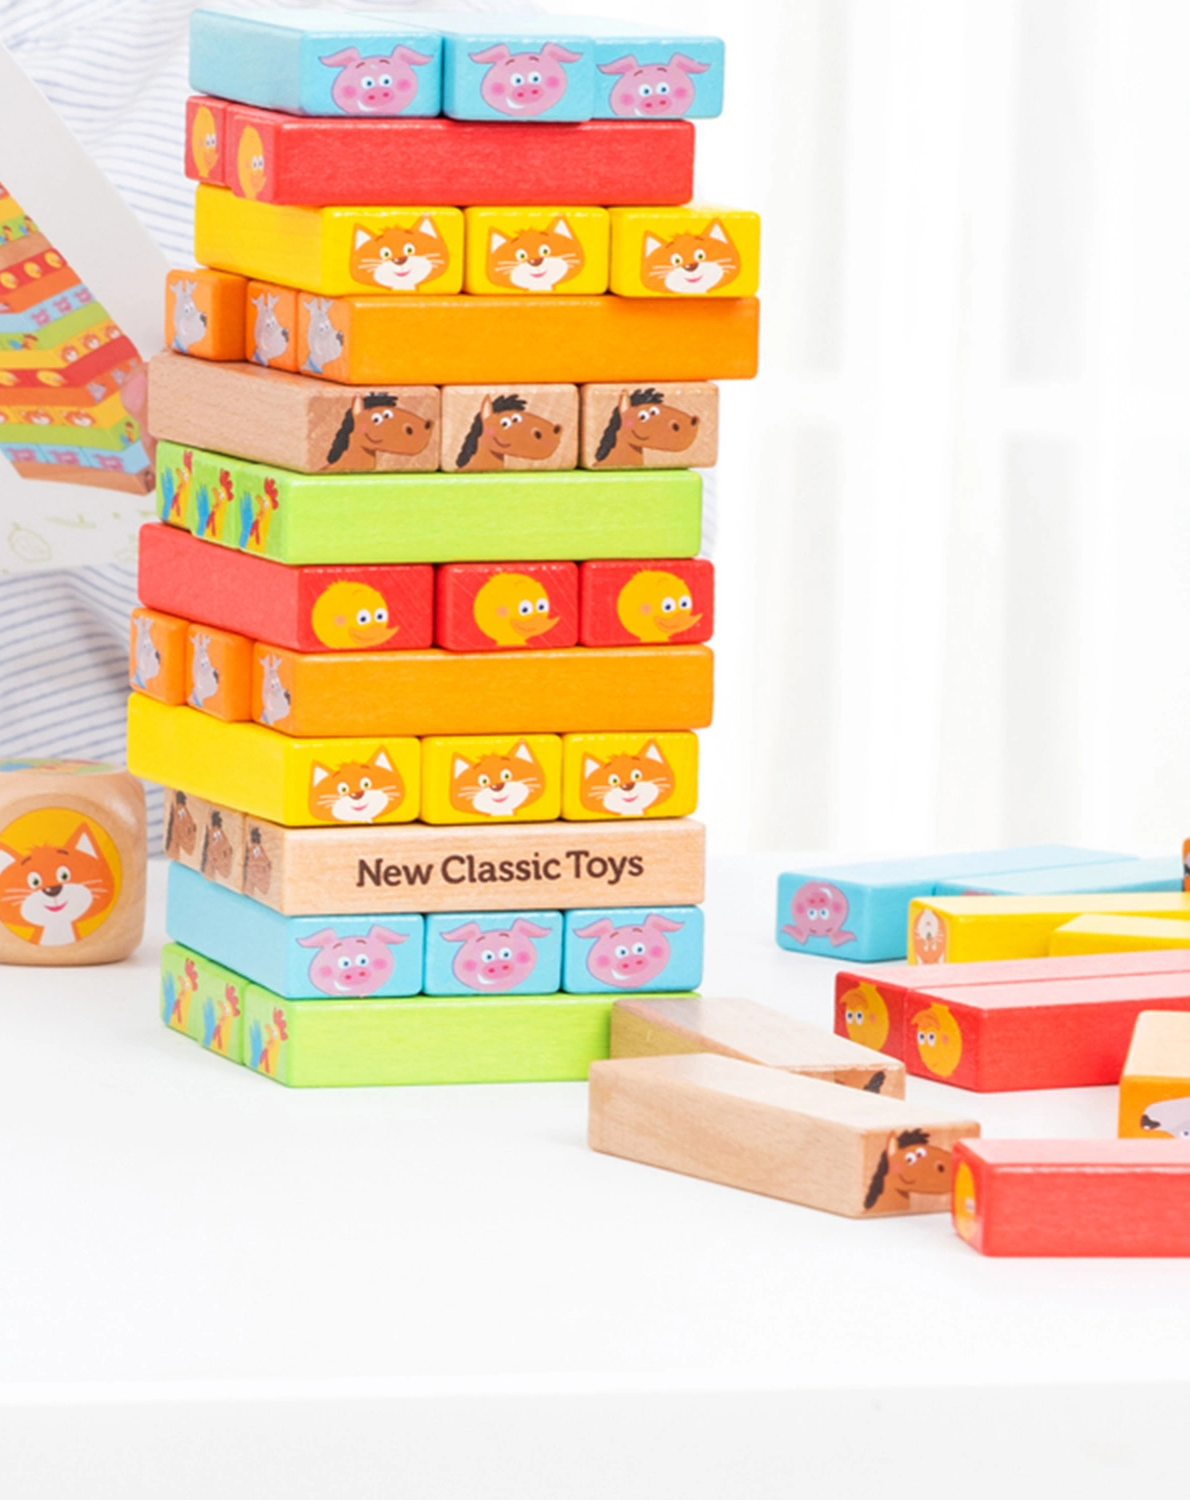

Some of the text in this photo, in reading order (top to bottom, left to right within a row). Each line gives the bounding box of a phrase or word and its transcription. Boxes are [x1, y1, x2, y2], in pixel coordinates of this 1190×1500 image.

[356, 850, 644, 888] New Classic Toys
